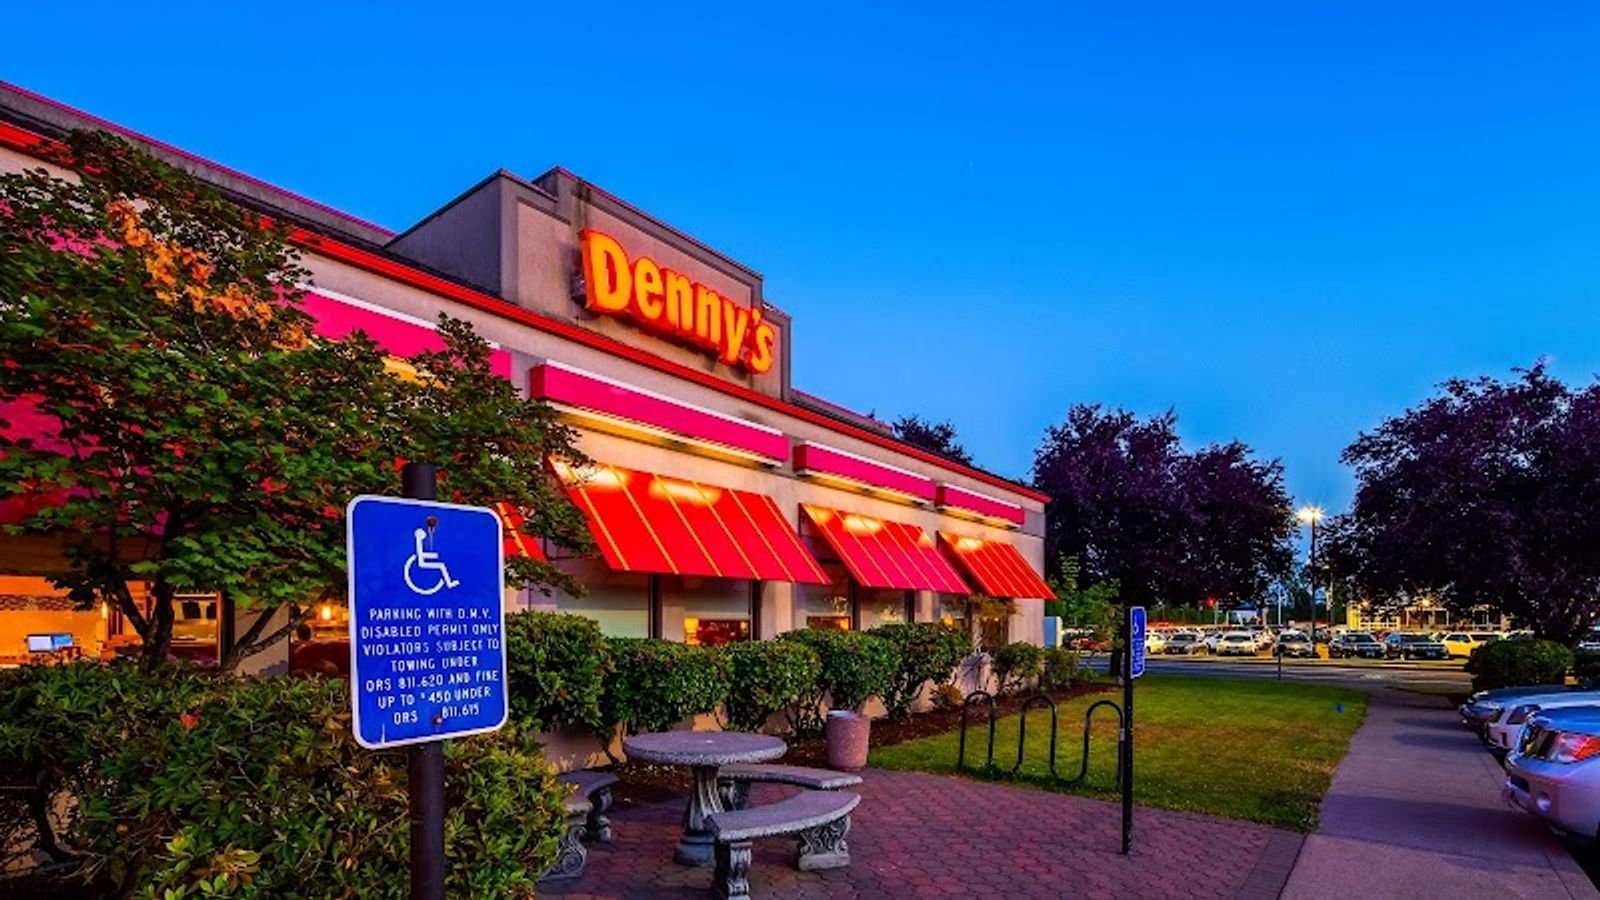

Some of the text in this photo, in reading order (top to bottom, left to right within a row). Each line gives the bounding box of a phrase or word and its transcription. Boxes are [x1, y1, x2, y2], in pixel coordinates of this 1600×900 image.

[581, 229, 775, 374] Denny's
[369, 608, 492, 620] PARKING WITH D.M.V.
[361, 623, 499, 639] DISABLED PERMIT ONLY
[362, 638, 500, 656] VIOLATORS SUBJECT TO
[391, 656, 478, 672] TOWING UNDER
[366, 670, 500, 693] ORS 811.620 AND FINE
[378, 696, 395, 710] UP
[400, 693, 415, 707] TO
[454, 686, 491, 701] UNDER
[393, 710, 418, 725] ORS
